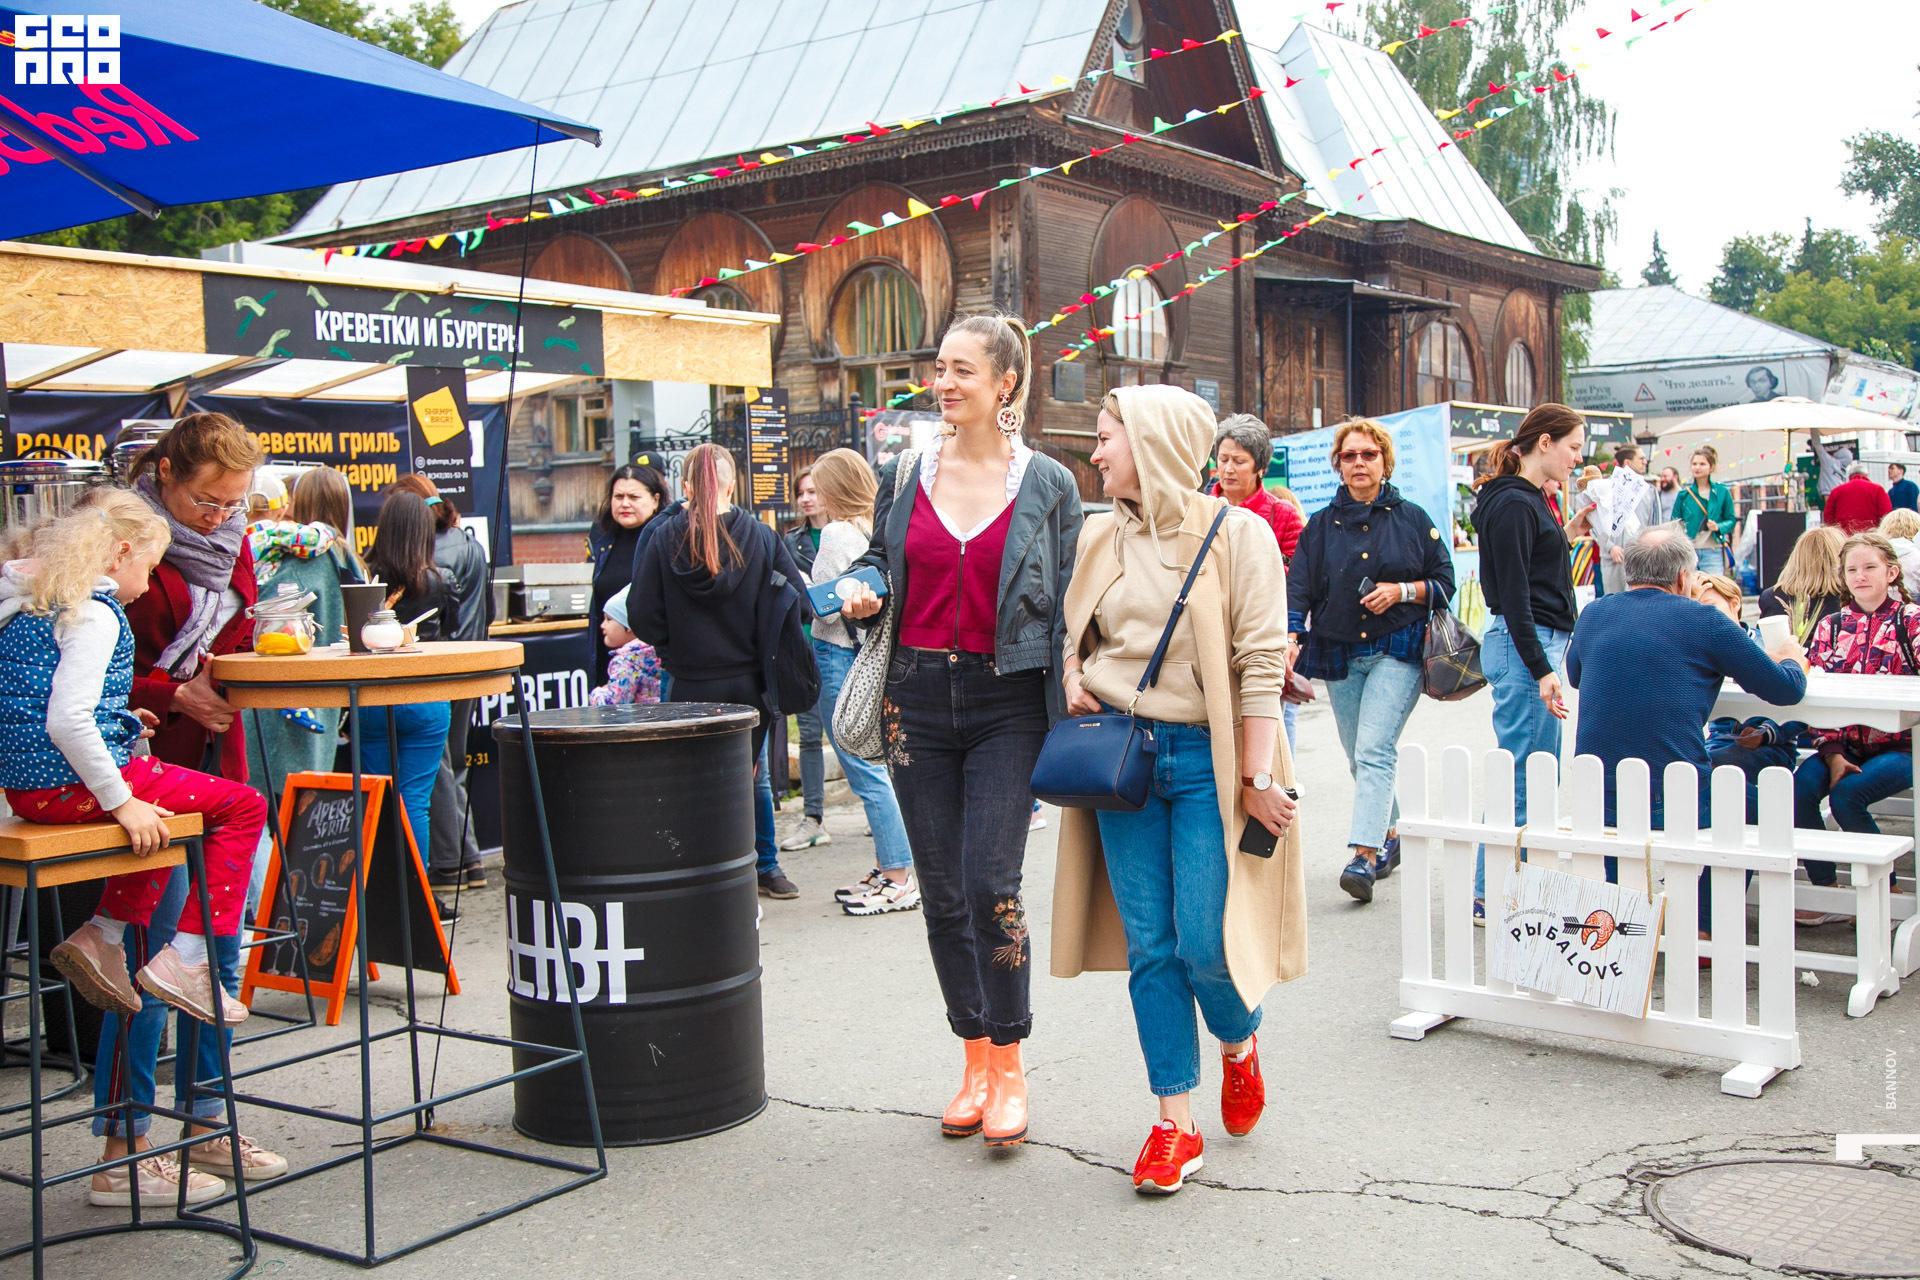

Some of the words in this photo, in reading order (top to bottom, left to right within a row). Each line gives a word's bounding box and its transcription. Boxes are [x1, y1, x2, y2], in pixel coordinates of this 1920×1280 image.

[314, 309, 420, 347] КРЕВЕТКИ
[424, 316, 438, 347] И
[441, 318, 524, 354] БУРГЕРЫ
[1665, 396, 1709, 406] НИКОЛАЙ
[248, 431, 334, 454] реветки
[339, 432, 401, 460] гриль
[1510, 921, 1623, 980] РЫБАLOVE
